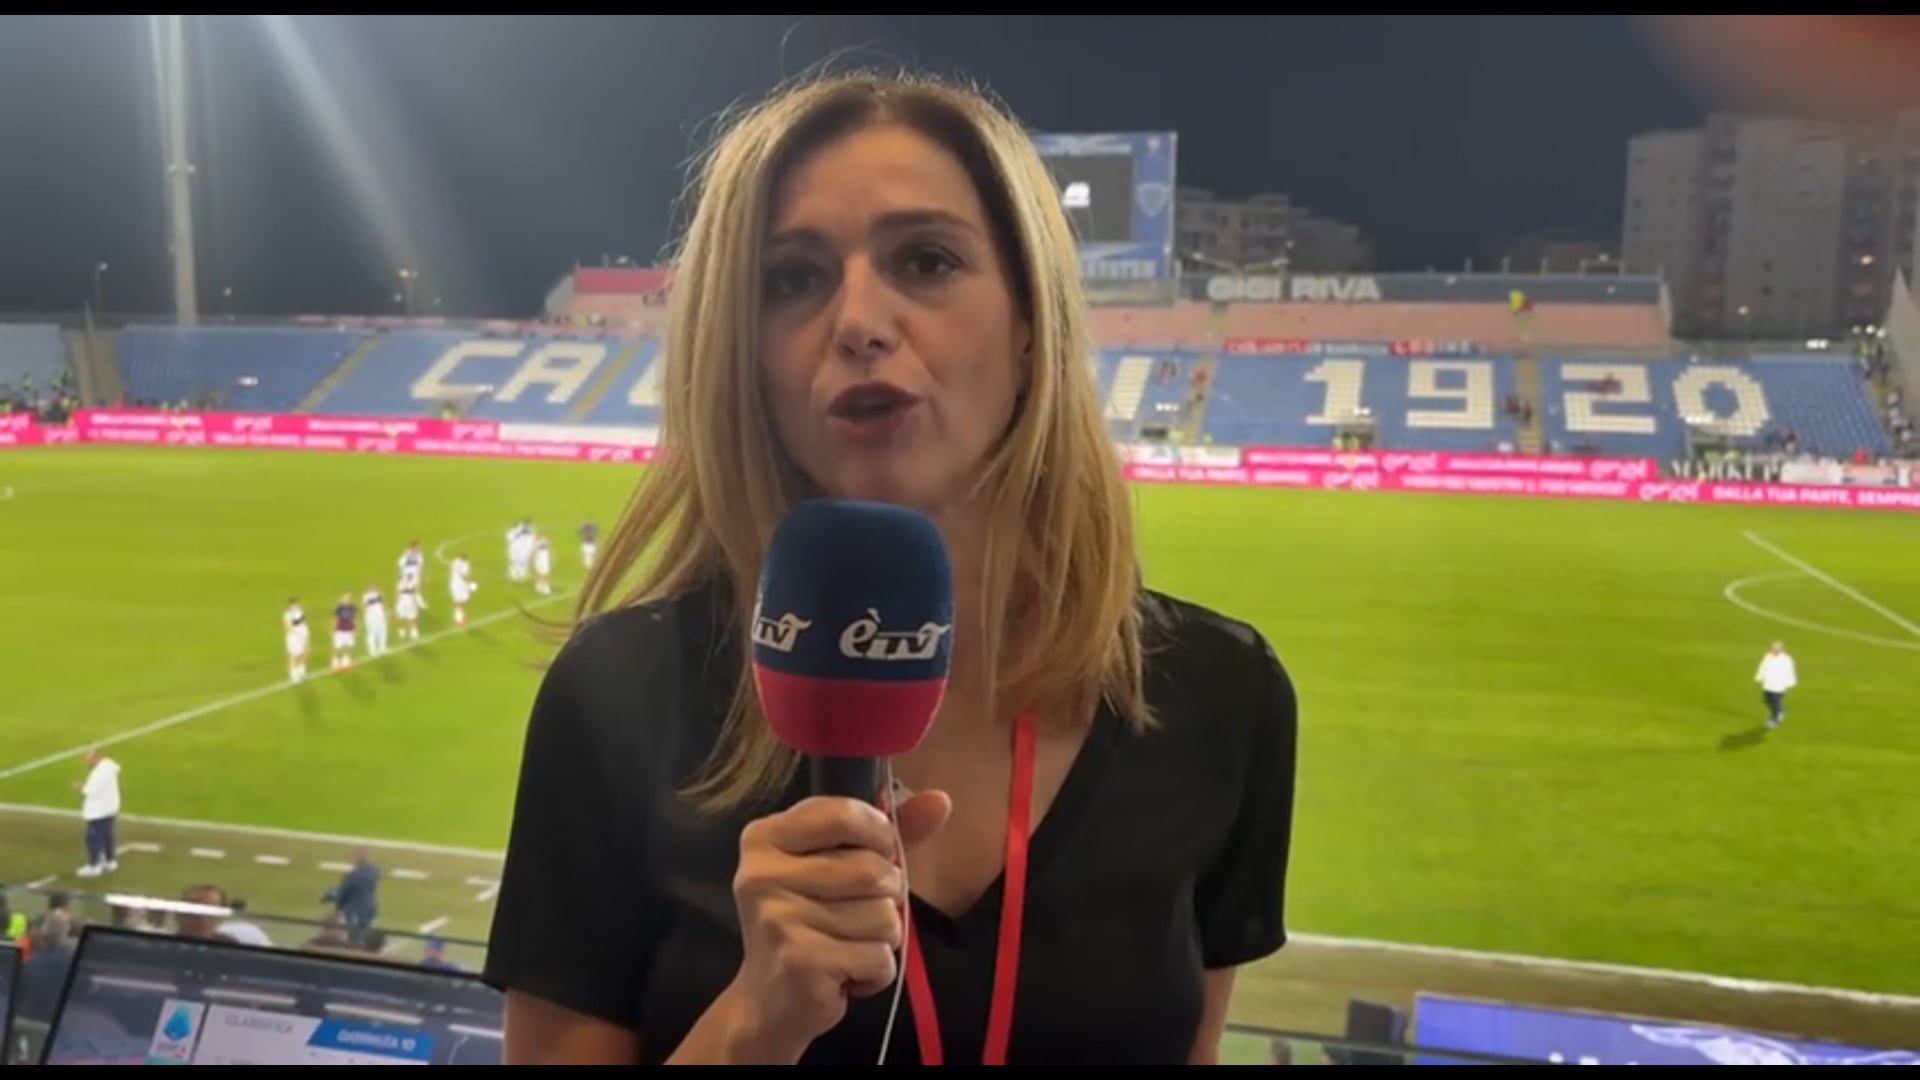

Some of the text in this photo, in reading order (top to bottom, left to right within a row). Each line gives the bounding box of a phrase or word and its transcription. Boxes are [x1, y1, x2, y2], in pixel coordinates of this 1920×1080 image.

[1207, 276, 1380, 299] GIGI RIVA
[1640, 480, 1697, 503] enel
[1712, 485, 1765, 501] DALLA
[1769, 487, 1799, 502] TUA
